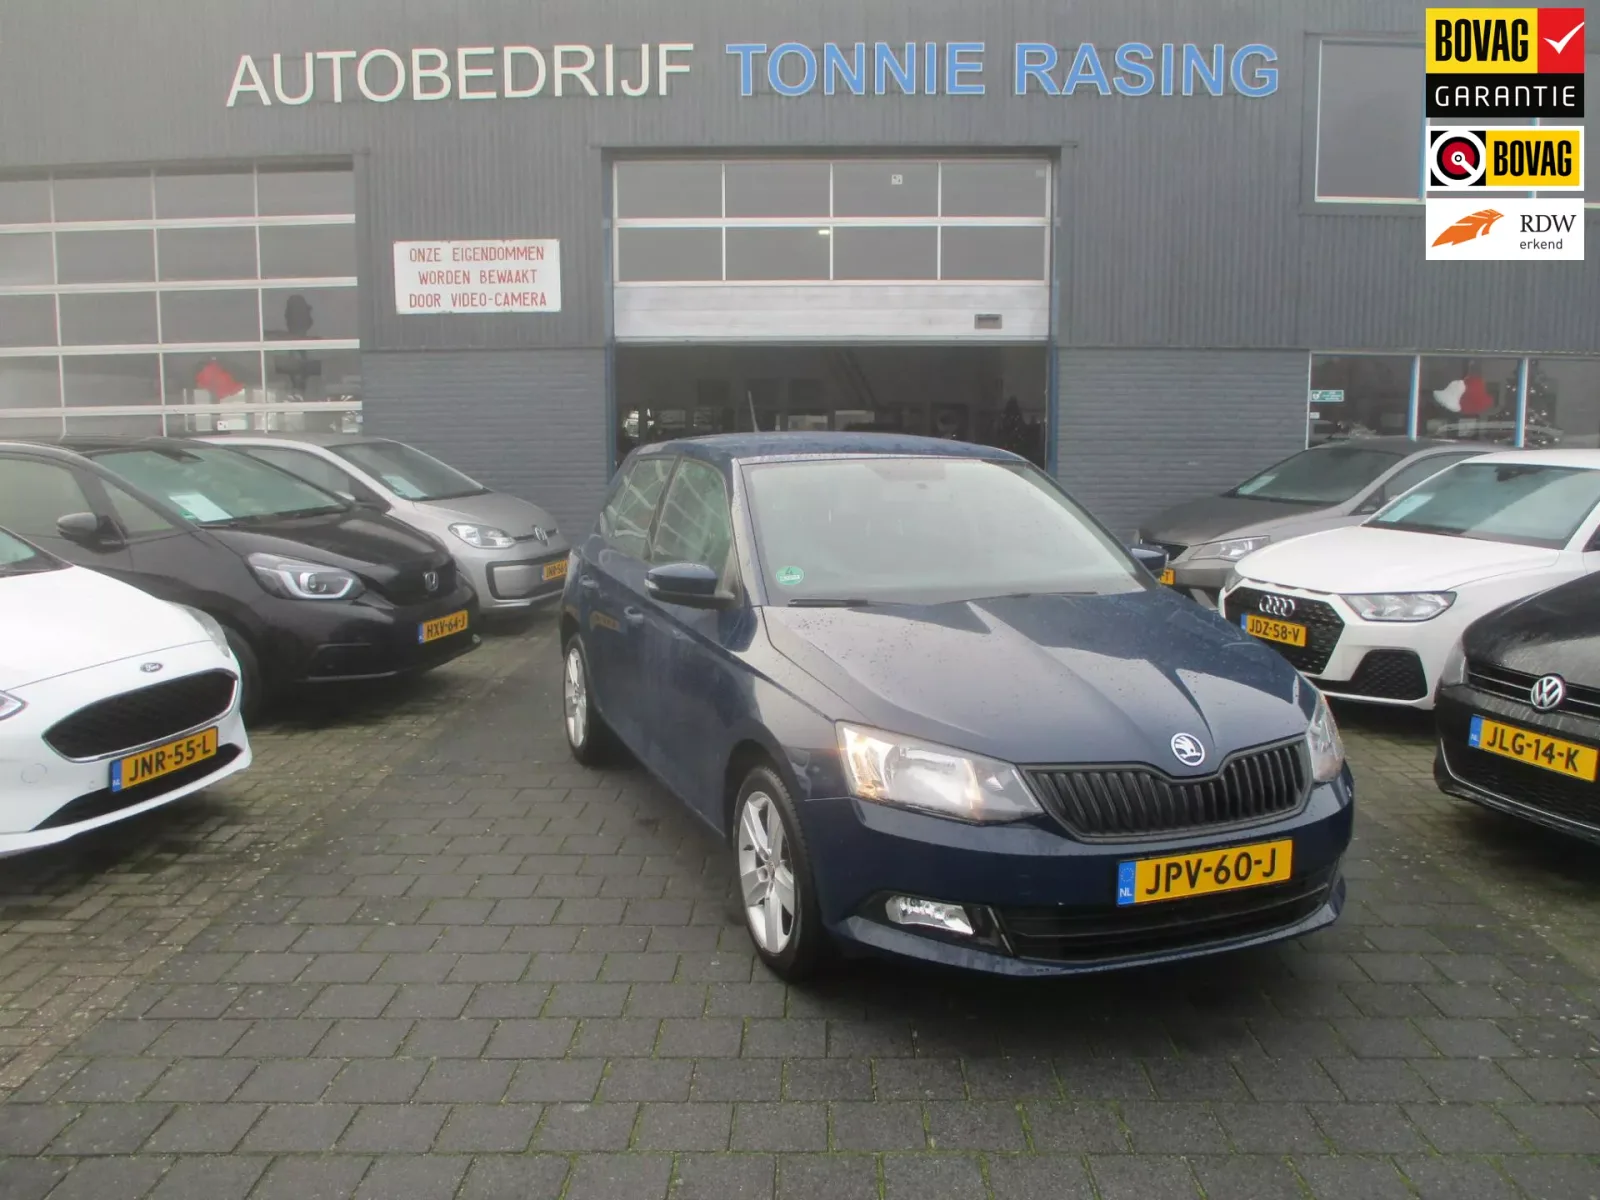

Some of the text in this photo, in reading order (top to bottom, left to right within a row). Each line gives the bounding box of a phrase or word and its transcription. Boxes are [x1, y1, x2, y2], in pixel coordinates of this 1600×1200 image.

[225, 41, 1279, 106] AUTOBEDRIJF TONNIE RASING
[409, 246, 544, 262] ONZE EIGENDOMMEN
[418, 269, 537, 285] WORDEN BEWAAKT
[409, 292, 547, 308] DOOR VIDEO-CAMERA
[426, 613, 466, 638] HXV-64-J
[1249, 618, 1300, 642] JDZ-58-V
[129, 735, 211, 782] JNR-55-L
[1487, 727, 1580, 772] JLG-14-K
[1119, 848, 1276, 897] NL JPV-60-J
